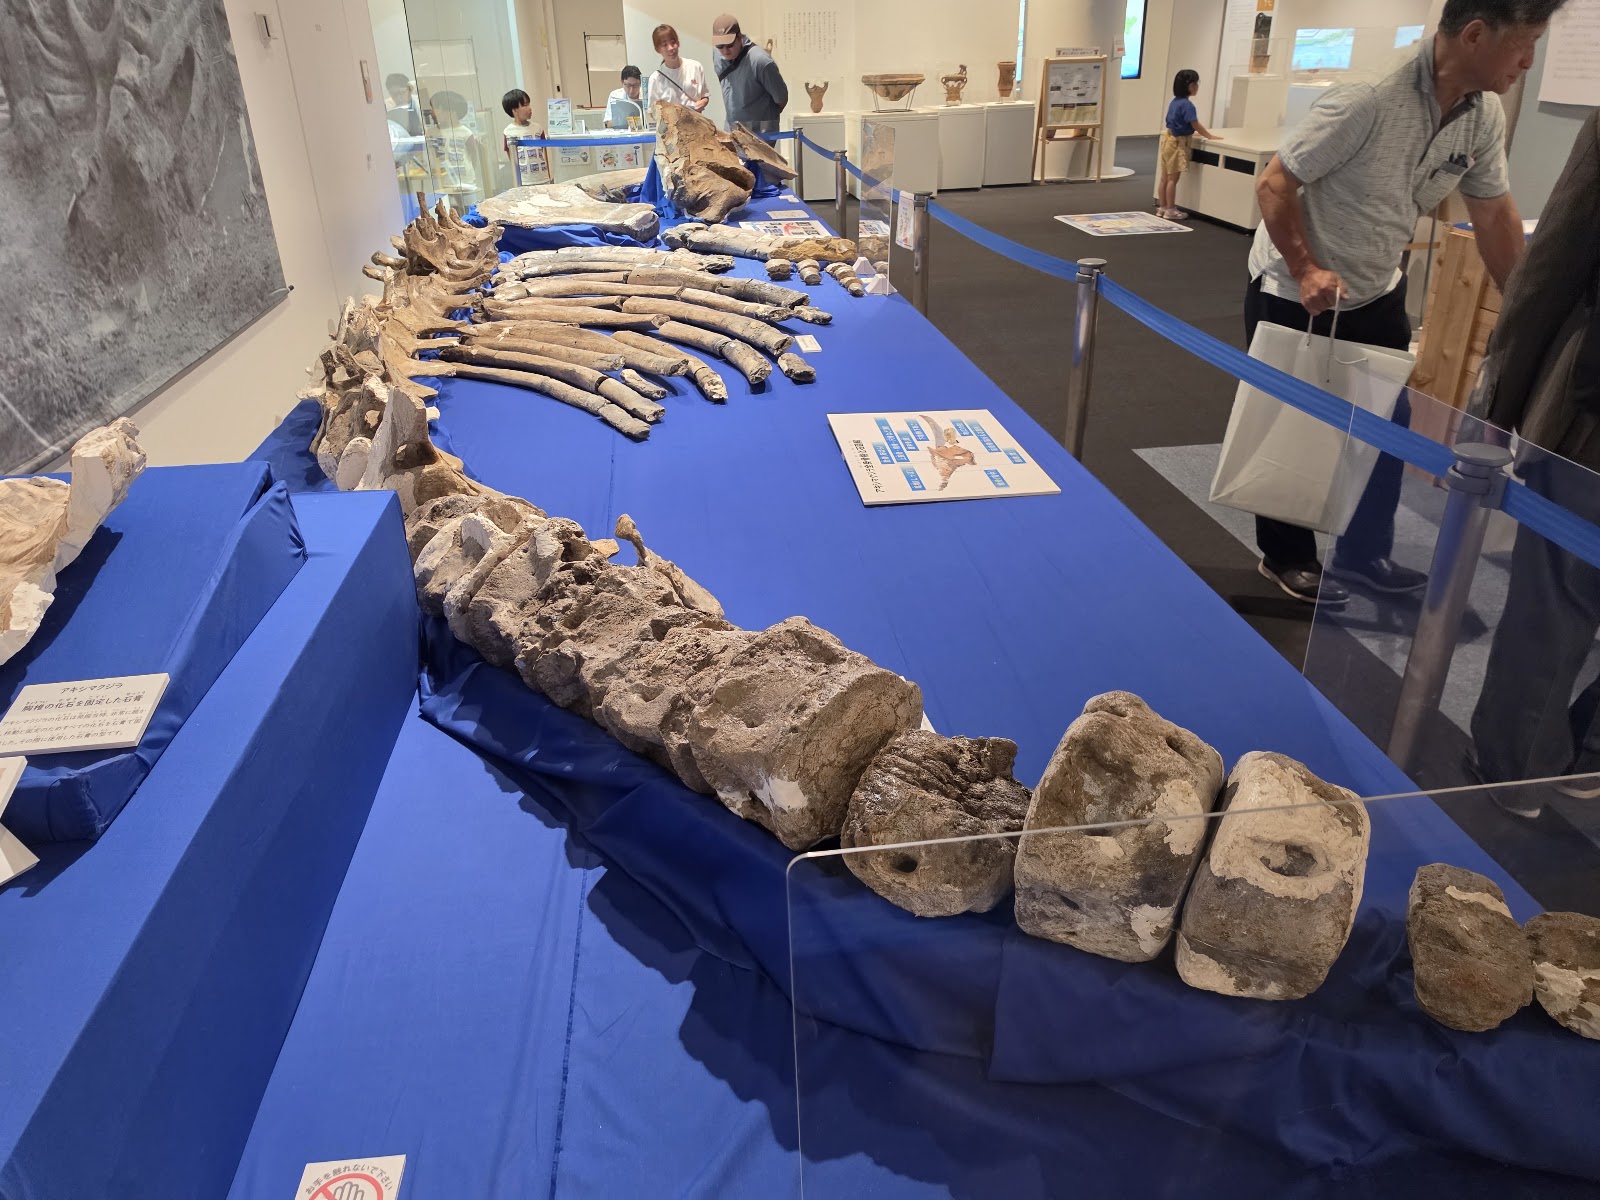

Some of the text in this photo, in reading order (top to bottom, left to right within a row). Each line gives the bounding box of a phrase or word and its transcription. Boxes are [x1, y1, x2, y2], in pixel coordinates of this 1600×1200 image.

[60, 682, 124, 695] アキシマクジラ
[21, 694, 144, 712] 胸椎の化石を固定した石膏
[305, 1163, 393, 1195] お手を触れないで下さい
